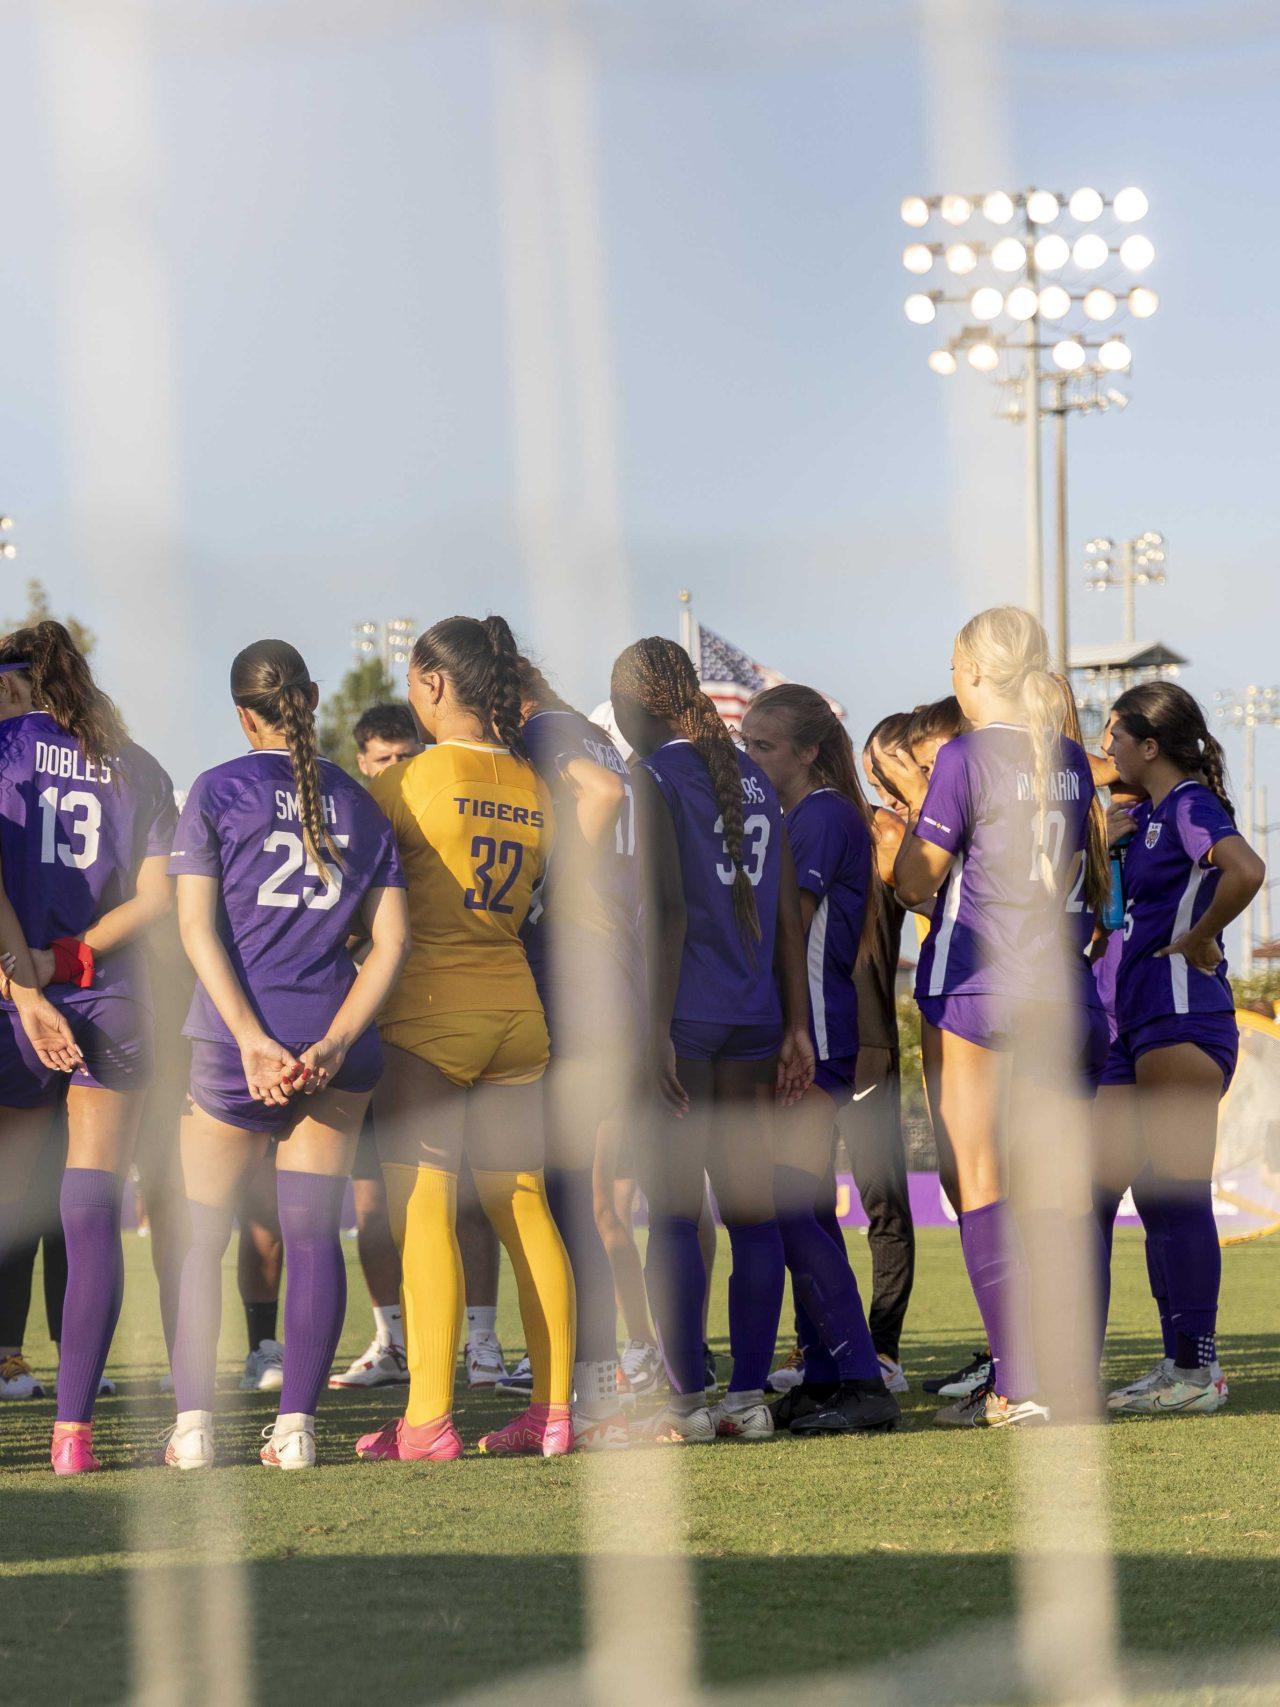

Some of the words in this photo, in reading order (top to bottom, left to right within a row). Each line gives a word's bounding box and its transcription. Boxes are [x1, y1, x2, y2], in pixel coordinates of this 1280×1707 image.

[38, 786, 102, 870] 13
[275, 789, 337, 824] SMH
[453, 797, 545, 829] TIGERS
[257, 830, 350, 911] 25
[463, 835, 523, 915] 32
